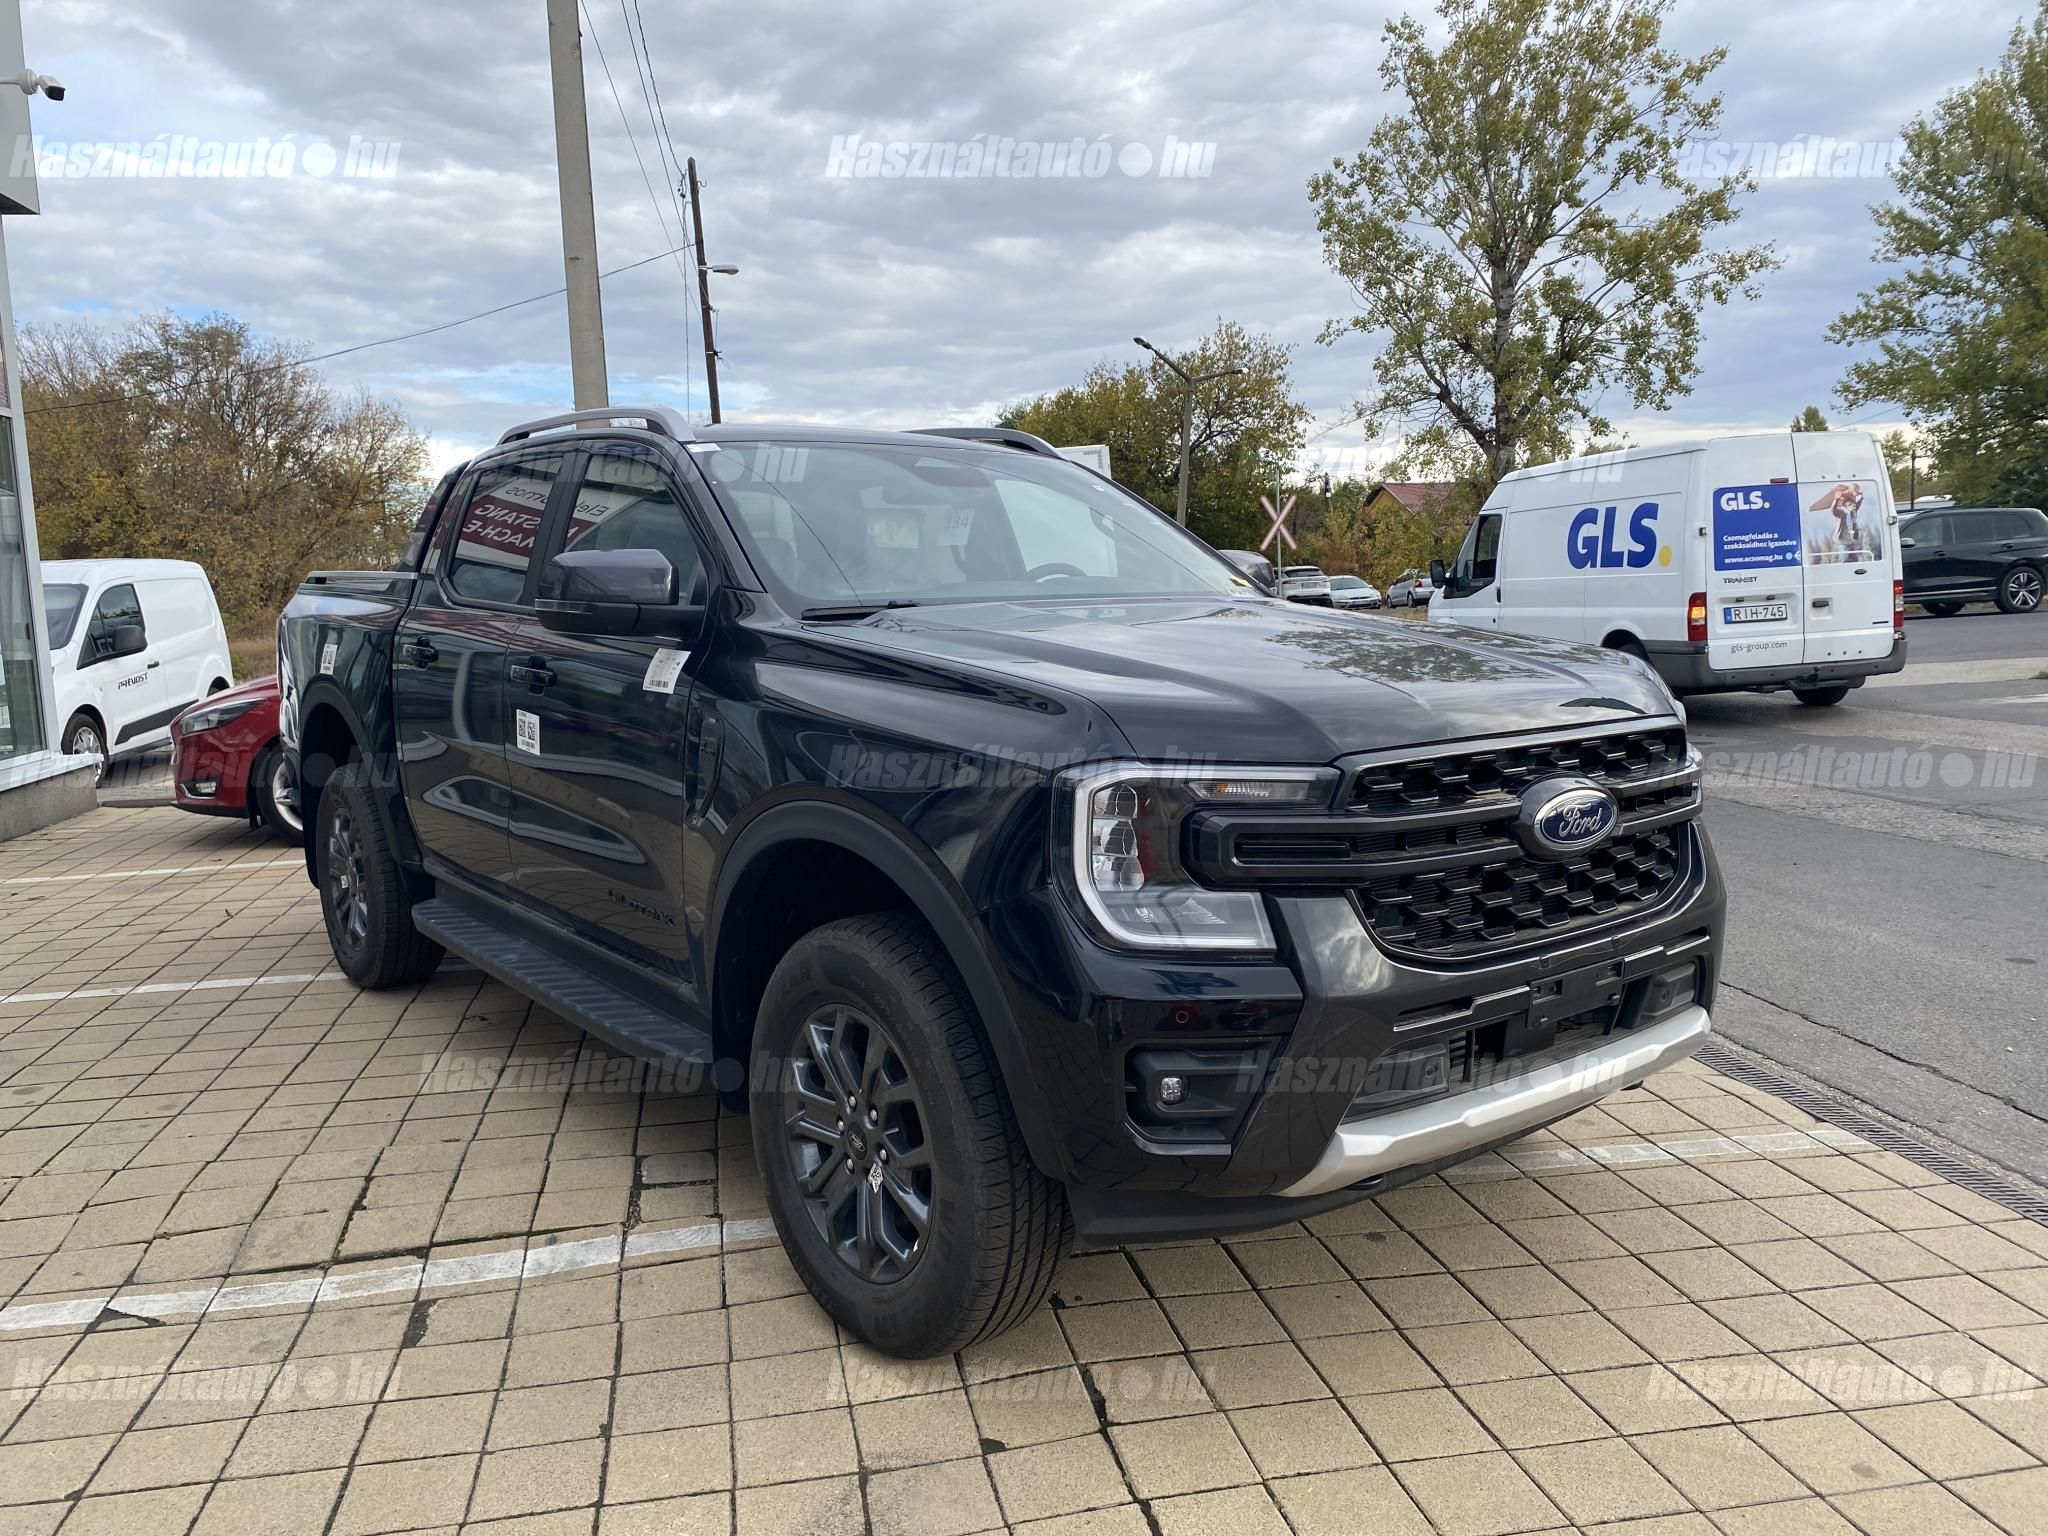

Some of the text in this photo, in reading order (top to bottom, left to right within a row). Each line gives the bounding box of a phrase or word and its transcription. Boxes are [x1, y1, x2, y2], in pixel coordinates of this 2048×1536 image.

[1733, 606, 1785, 620] RIH-745
[1731, 641, 1788, 654] gls-group.com
[1558, 802, 1603, 838] Ford
